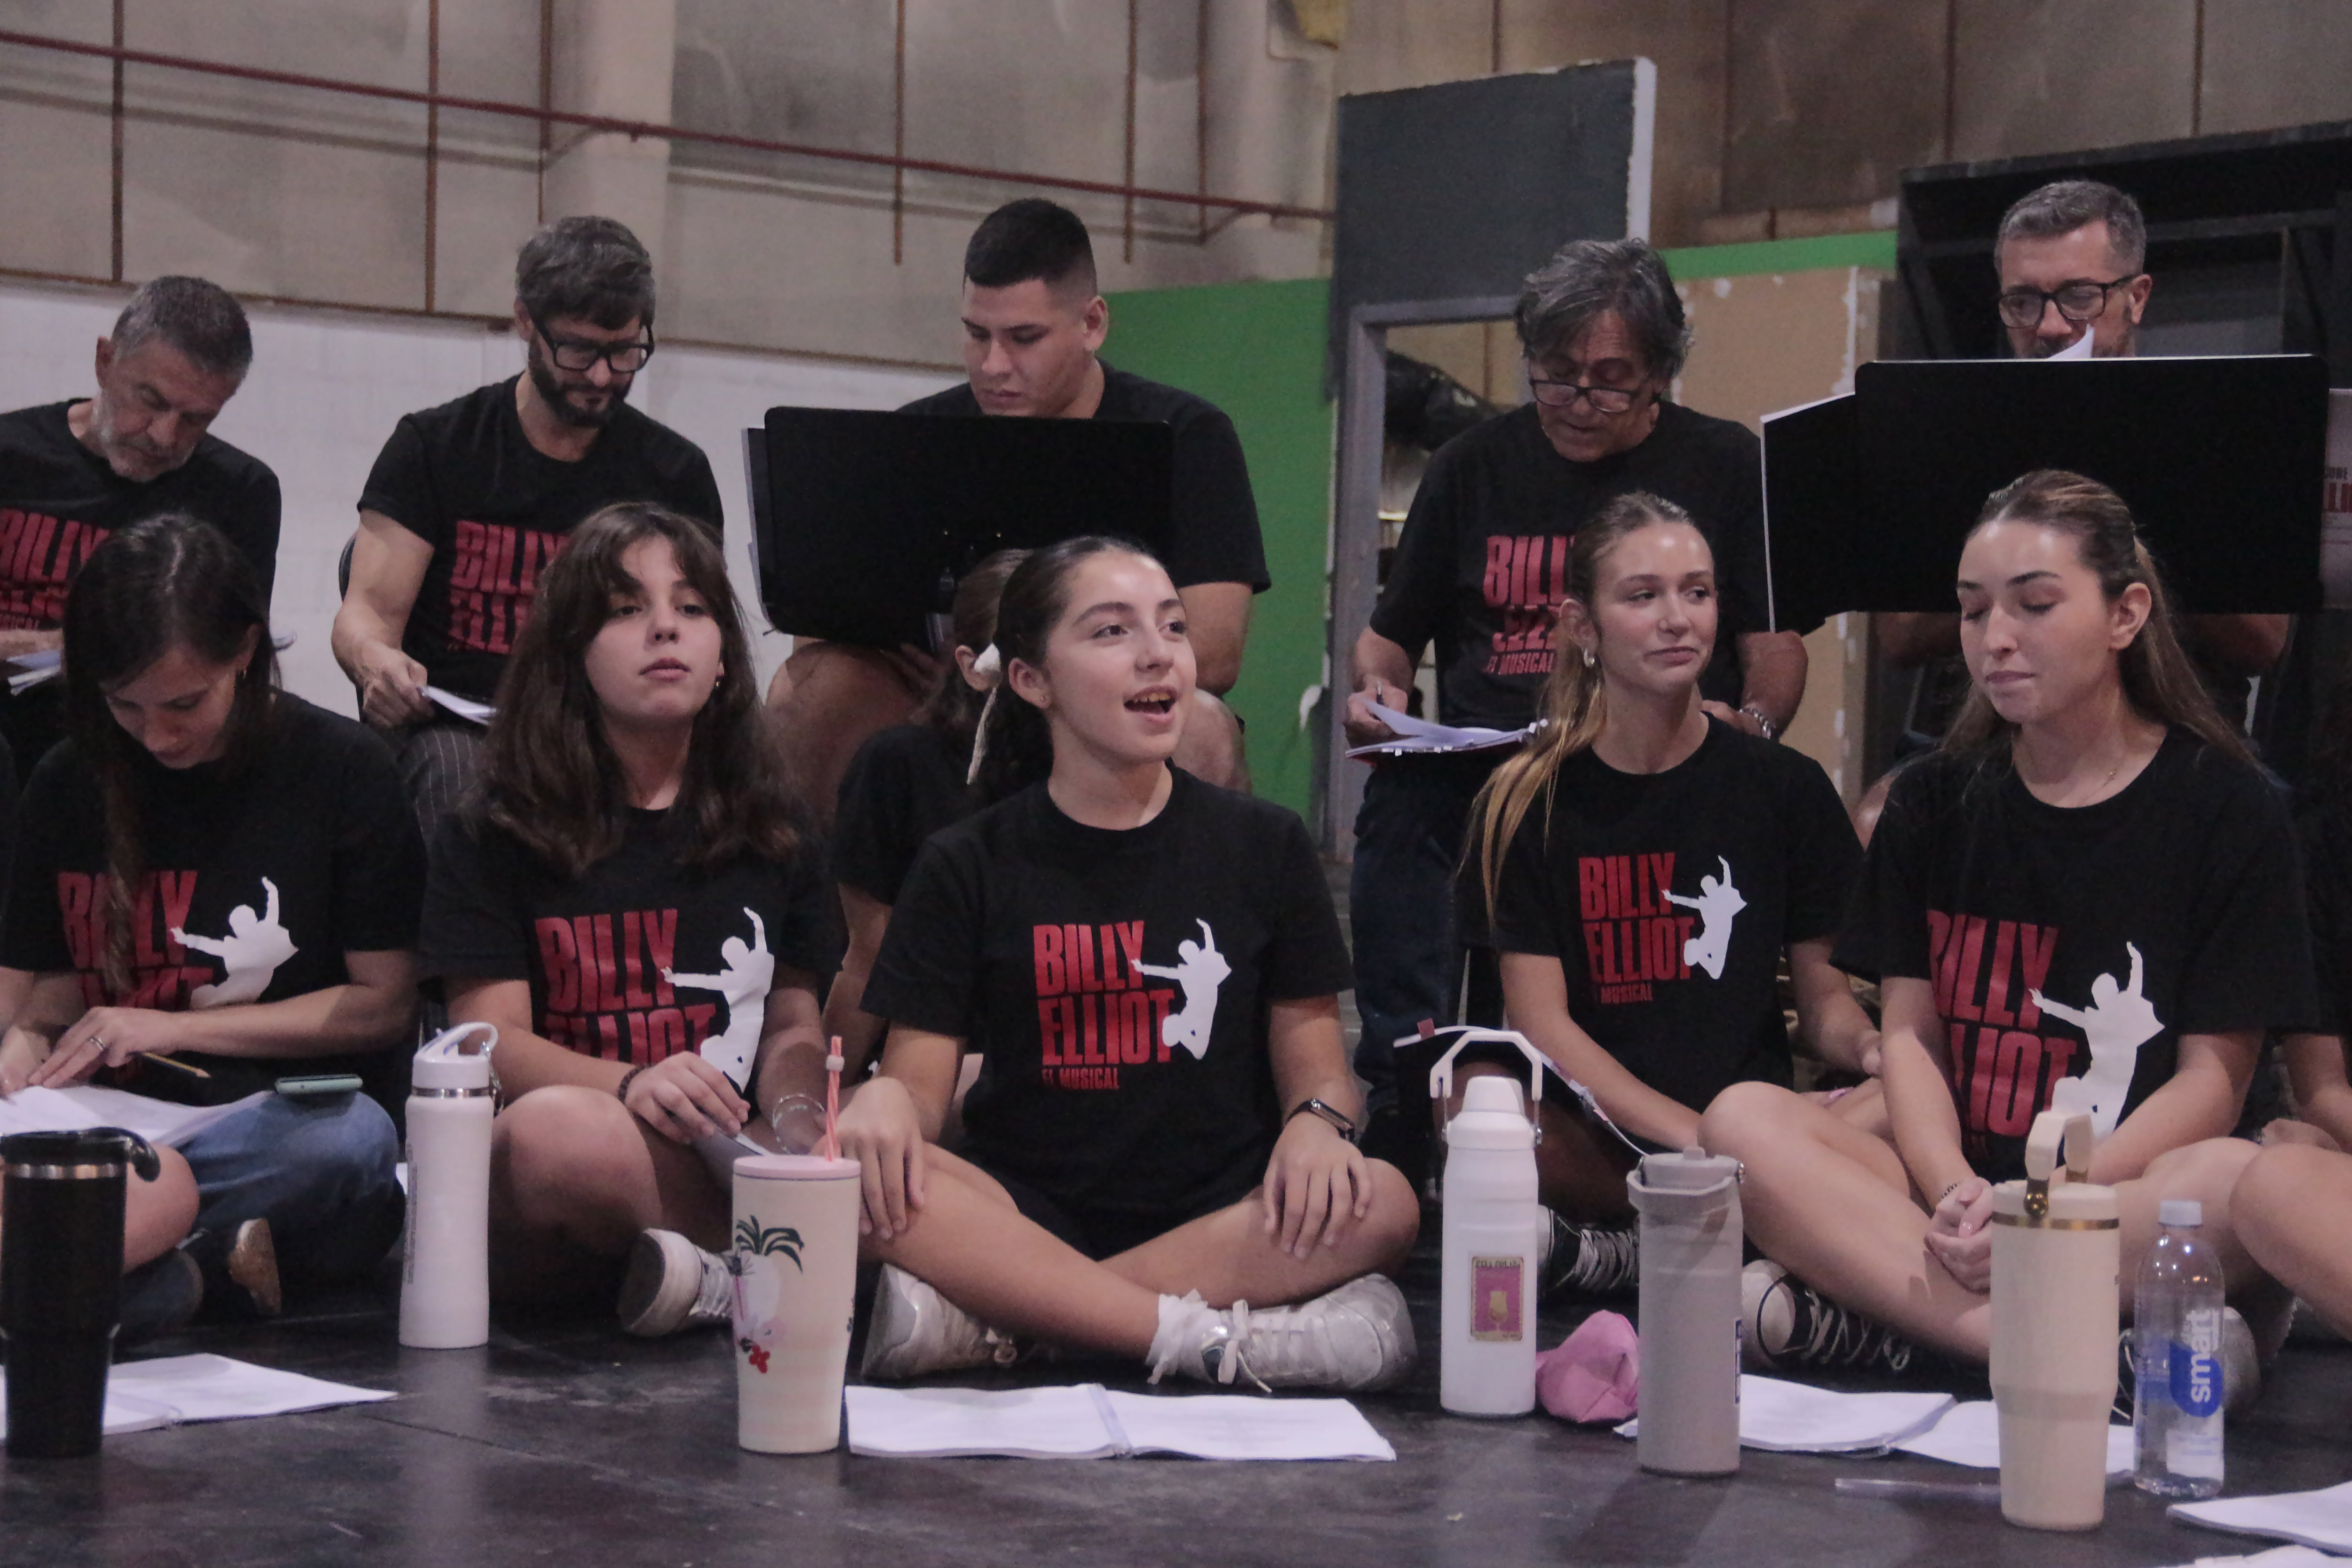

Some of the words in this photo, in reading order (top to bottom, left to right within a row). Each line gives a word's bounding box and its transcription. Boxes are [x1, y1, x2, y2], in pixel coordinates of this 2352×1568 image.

[1483, 534, 1574, 607] BILL
[1579, 852, 1676, 920] BILLY
[535, 908, 677, 1013] BILLY
[1033, 920, 1144, 996] BILLY
[1582, 915, 1694, 984] ELLIOT
[1037, 989, 1175, 1066] ELLIOT
[1059, 1067, 1120, 1090] MUSICAL
[2185, 1310, 2212, 1404] smart
